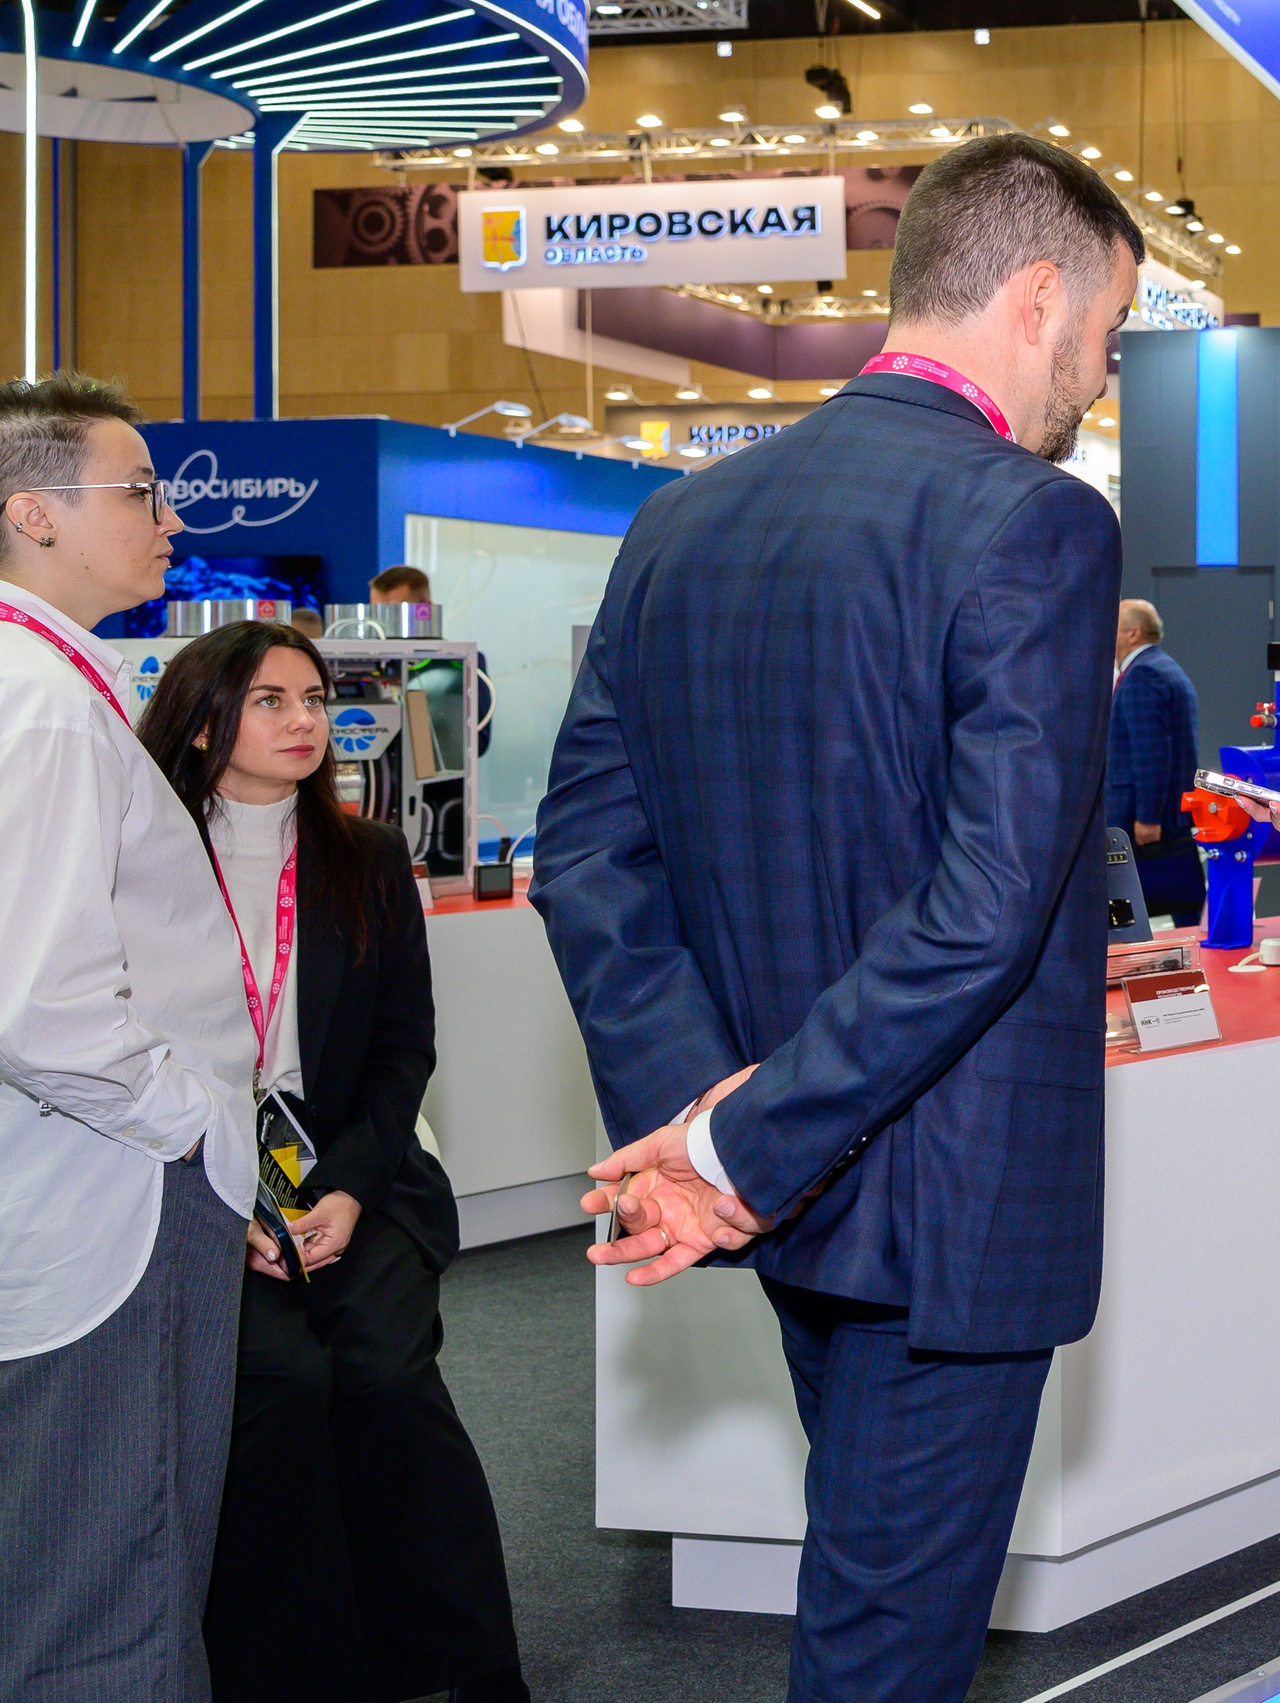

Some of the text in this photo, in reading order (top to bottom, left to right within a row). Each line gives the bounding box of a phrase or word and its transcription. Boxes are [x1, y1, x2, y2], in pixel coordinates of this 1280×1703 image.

[544, 204, 821, 243] КИРОВСКАЯ
[544, 244, 648, 265] ОБЛАСТЬ
[689, 423, 792, 444] КИРОВ
[330, 727, 389, 735] ТМОСФЕРА
